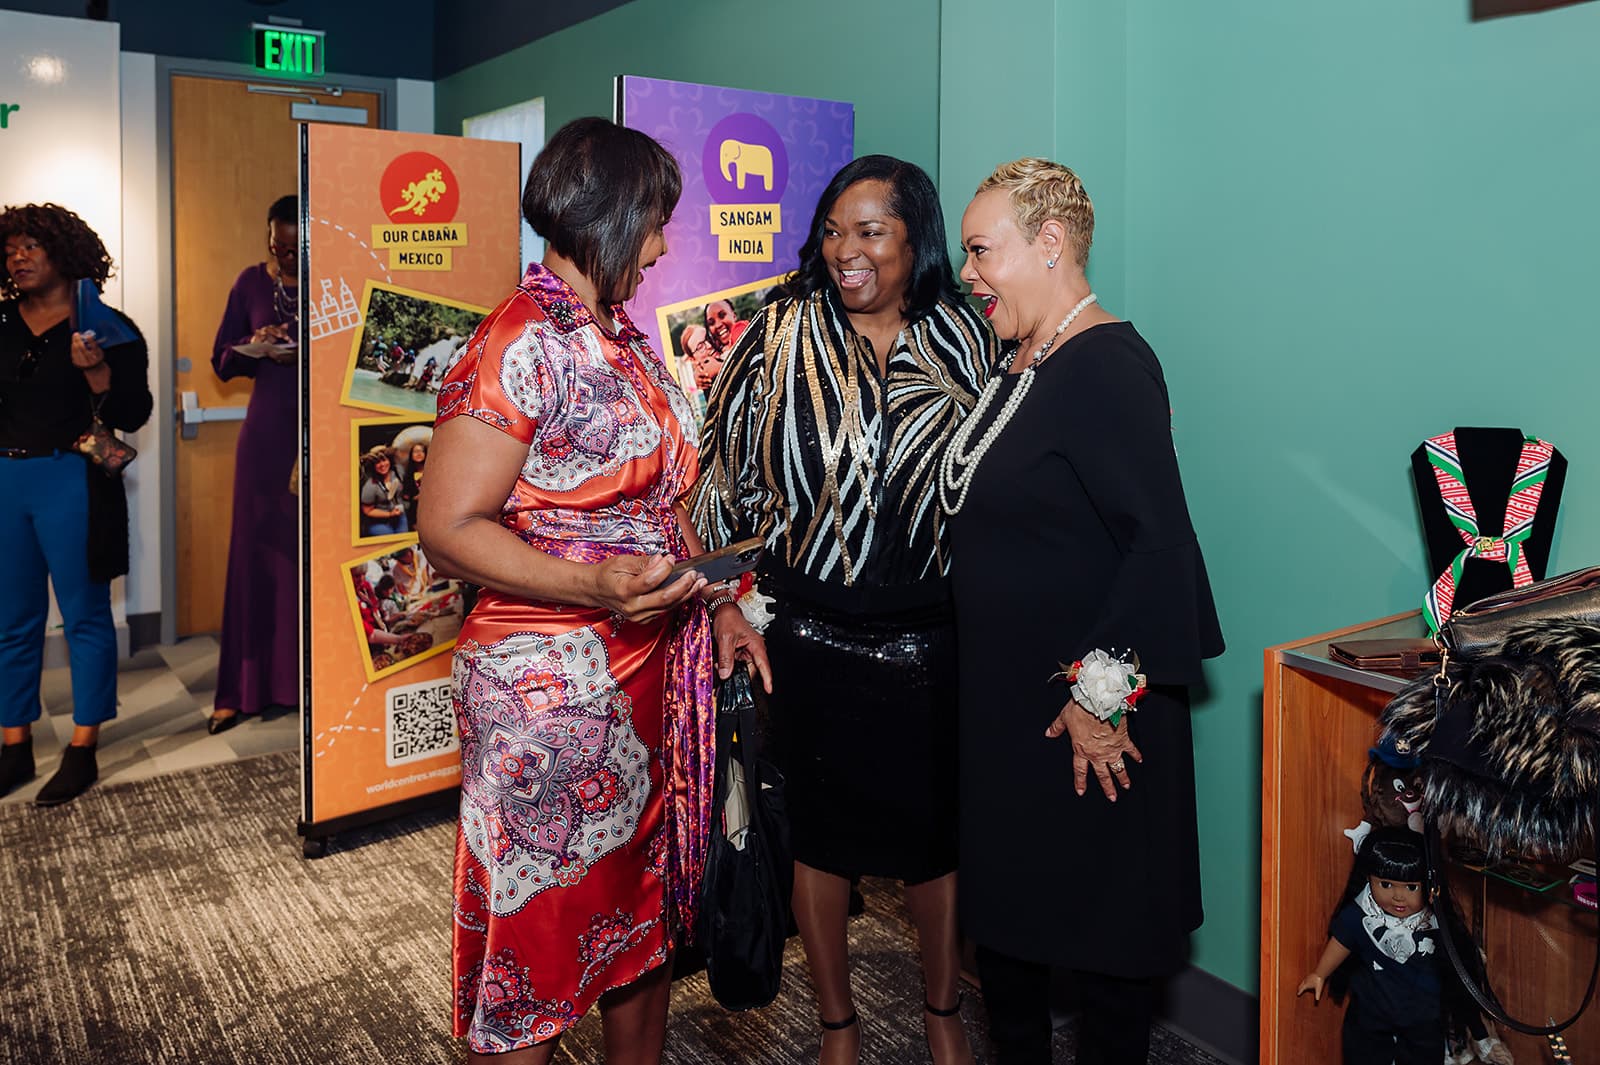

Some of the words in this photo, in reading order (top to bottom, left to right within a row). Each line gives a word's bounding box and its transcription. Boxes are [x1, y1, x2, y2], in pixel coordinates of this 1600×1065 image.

[265, 31, 316, 73] EXIT
[720, 211, 772, 226] SANGAM
[383, 231, 408, 243] OUR
[412, 226, 458, 242] CABAÑA
[729, 240, 764, 254] INDIA
[399, 253, 443, 265] MEXICO
